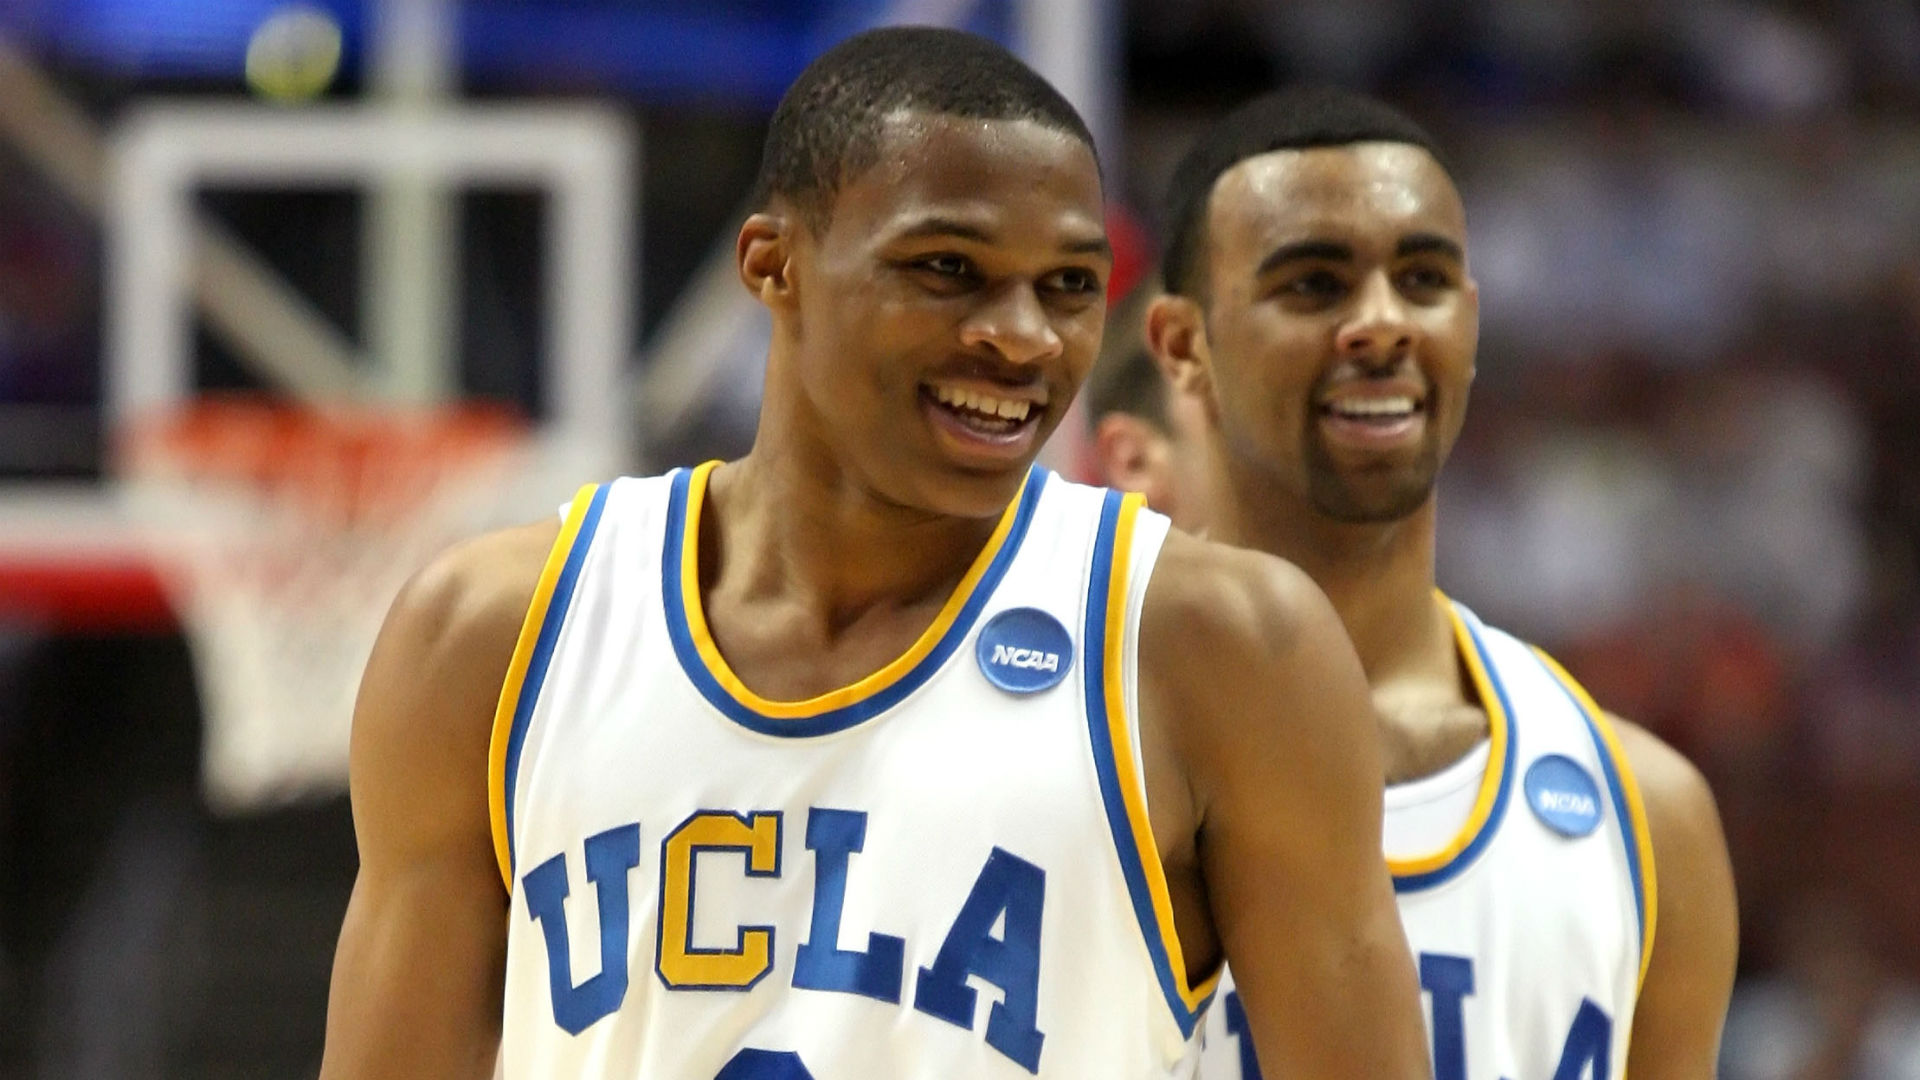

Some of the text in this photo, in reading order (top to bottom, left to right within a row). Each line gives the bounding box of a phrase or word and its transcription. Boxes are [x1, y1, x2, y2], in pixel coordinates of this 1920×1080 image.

[991, 644, 1059, 673] NCAA
[1540, 788, 1597, 816] NCAA
[522, 807, 1046, 1076] UCLA
